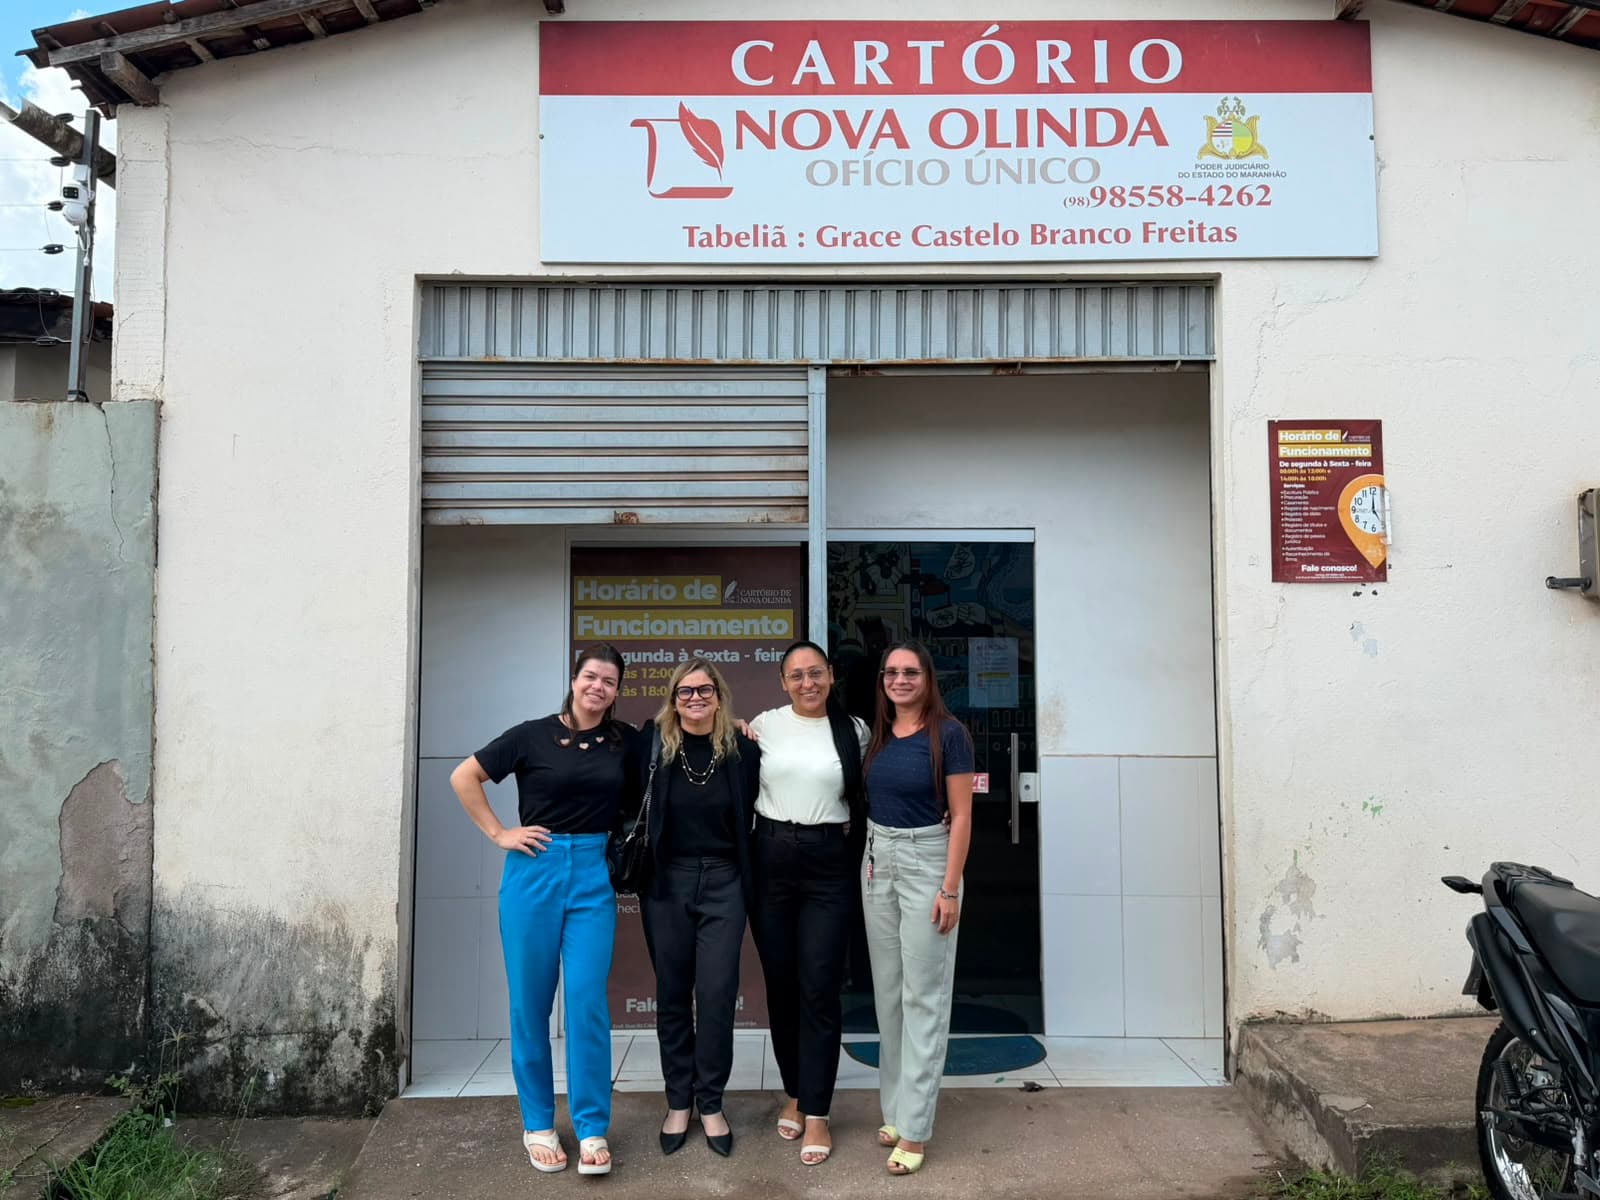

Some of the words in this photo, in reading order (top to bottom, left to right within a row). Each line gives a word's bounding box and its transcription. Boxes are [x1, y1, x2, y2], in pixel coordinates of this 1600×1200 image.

[731, 24, 1183, 87] CARTÓRIO
[735, 108, 911, 151] NOVA
[928, 106, 1169, 150] OLINDA
[805, 150, 951, 187] OFÍCIO
[964, 149, 1102, 185] ÚNICO
[1194, 163, 1224, 171] PODER
[1224, 162, 1270, 171] JUDICIÁRIO
[1177, 171, 1191, 179] DO
[1191, 171, 1225, 179] ESTADO
[1225, 171, 1239, 179] DO
[1239, 169, 1288, 179] MARANHÃO
[682, 223, 788, 248] Tabeliã
[815, 225, 902, 248] Grace
[911, 222, 1020, 248] Castelo
[1030, 223, 1132, 246] Branco
[1142, 219, 1239, 244] Freitas
[1279, 430, 1323, 441] Horário
[1325, 431, 1340, 441] de
[1280, 445, 1370, 456] Funcionamento
[1290, 460, 1322, 469] segunda
[1361, 490, 1367, 498] 11
[1369, 487, 1377, 496] 12
[1354, 497, 1363, 506] 10
[1351, 505, 1357, 514] 9
[1354, 514, 1360, 524] 8
[1362, 521, 1368, 530] 7
[1371, 524, 1377, 533] 6
[1301, 564, 1320, 573] Fale
[1321, 564, 1358, 572] conosco!
[576, 578, 678, 601] Horário
[683, 579, 718, 600] de
[577, 613, 788, 636] Funcionamento
[621, 649, 674, 665] gunda
[678, 648, 689, 662] à
[692, 648, 740, 662] Sexta
[754, 648, 785, 662] feir
[623, 684, 638, 697] às
